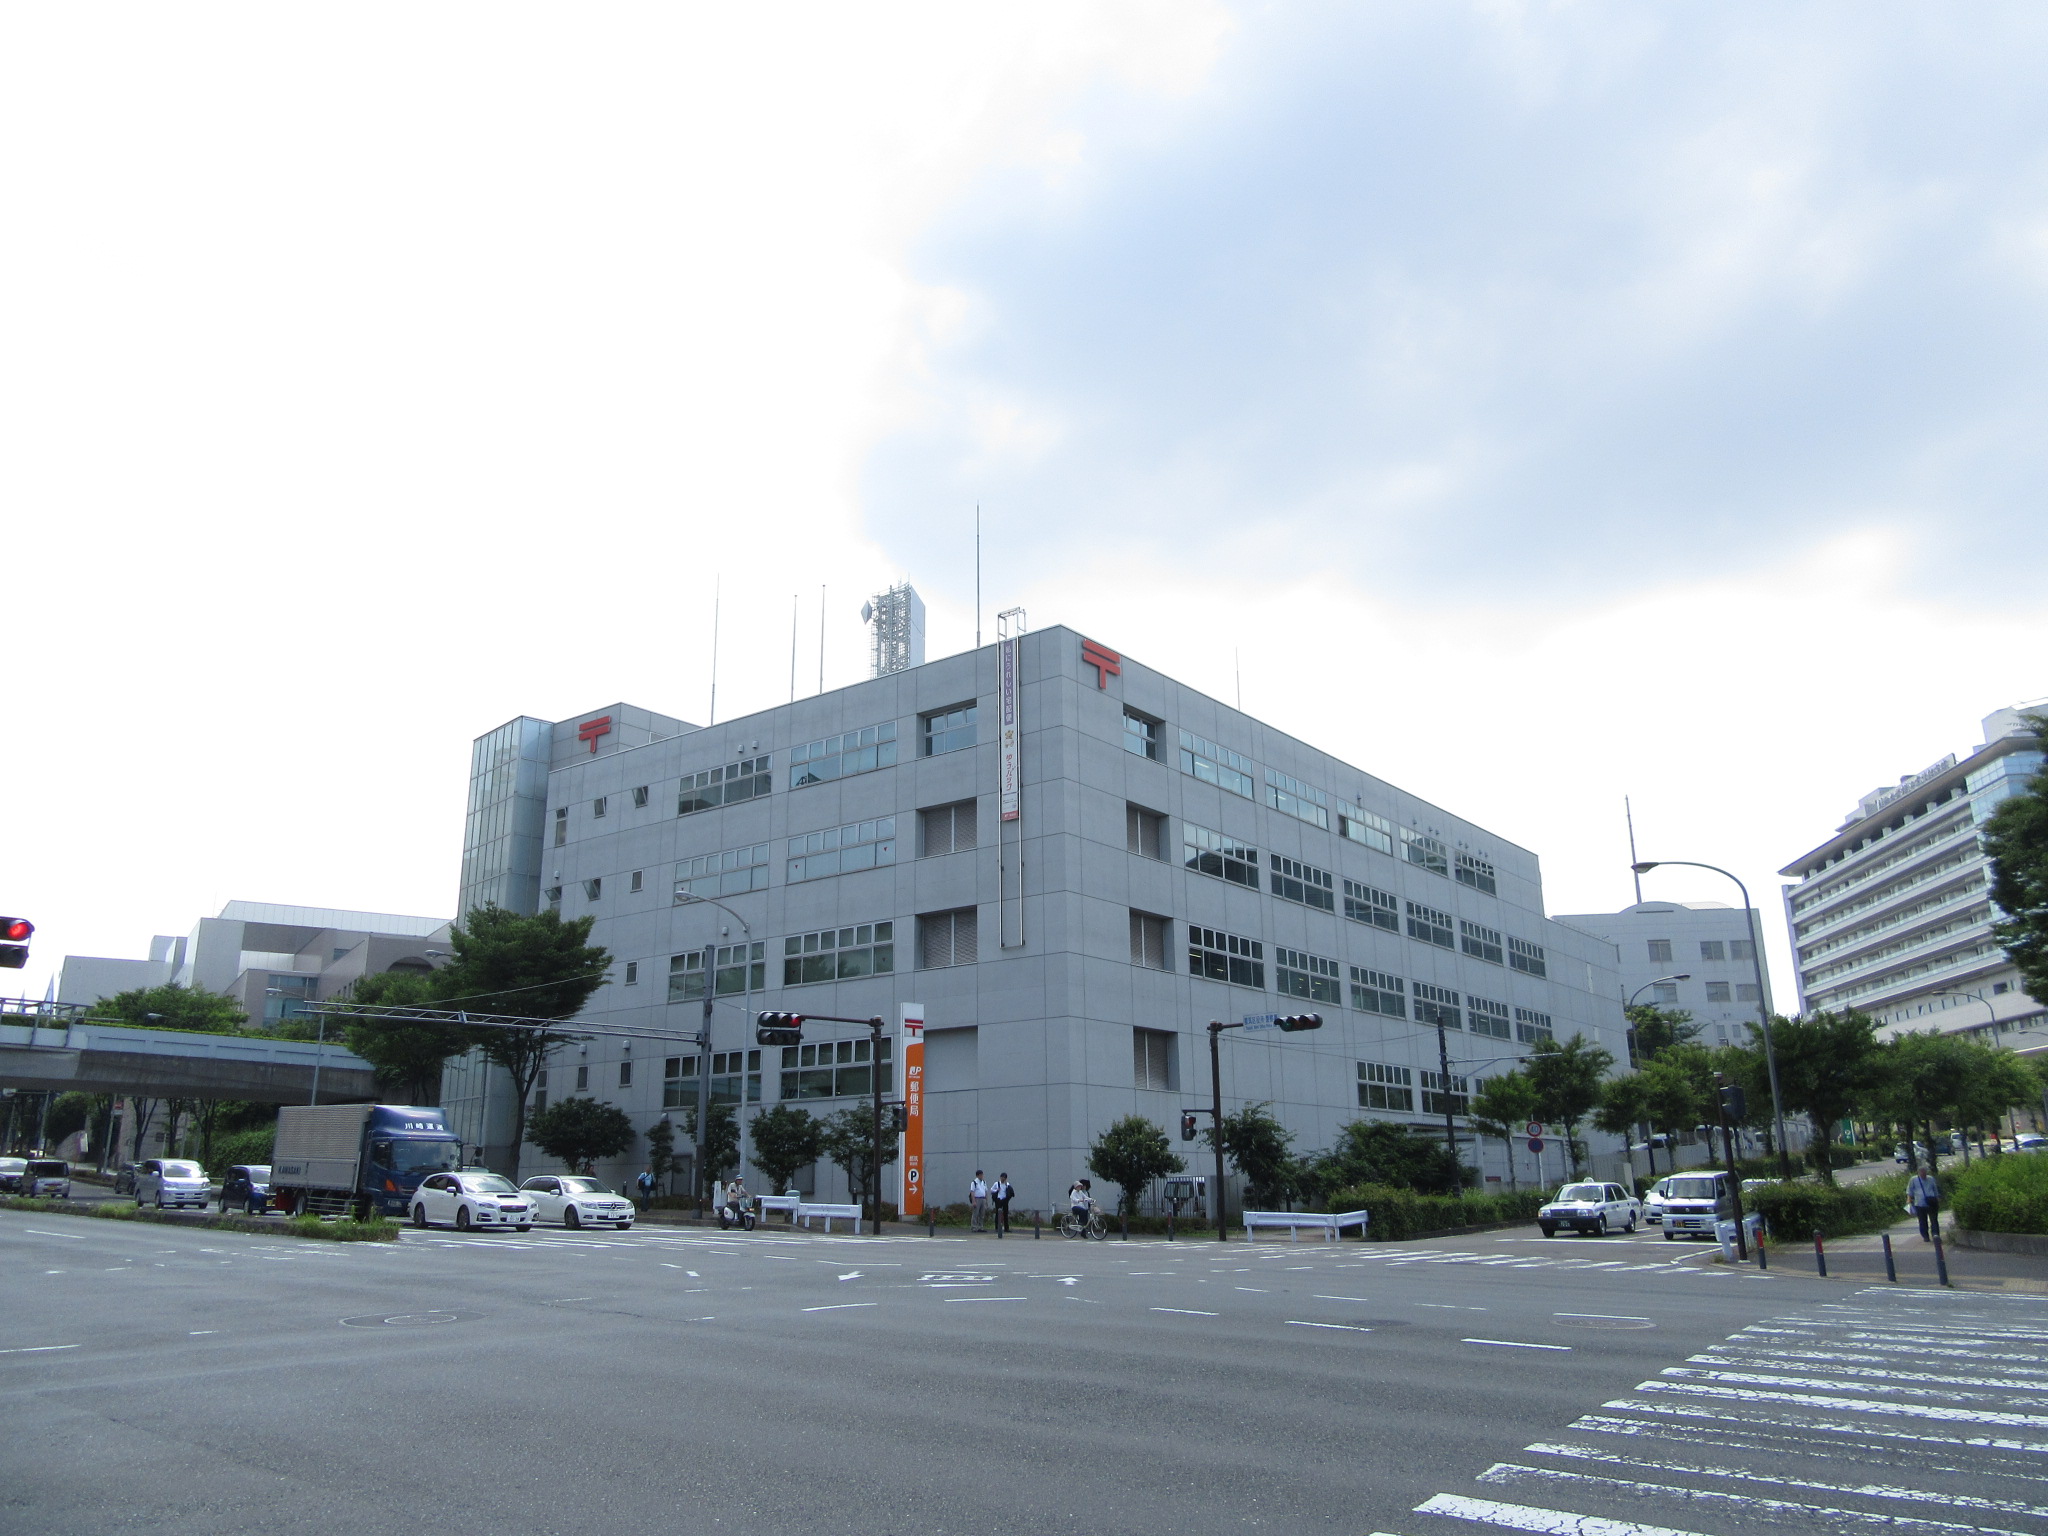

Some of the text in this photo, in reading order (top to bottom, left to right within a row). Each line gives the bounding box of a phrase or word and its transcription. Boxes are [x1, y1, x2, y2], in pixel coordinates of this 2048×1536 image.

[910, 1081, 919, 1117] 郵便局
[910, 1170, 917, 1181] P
